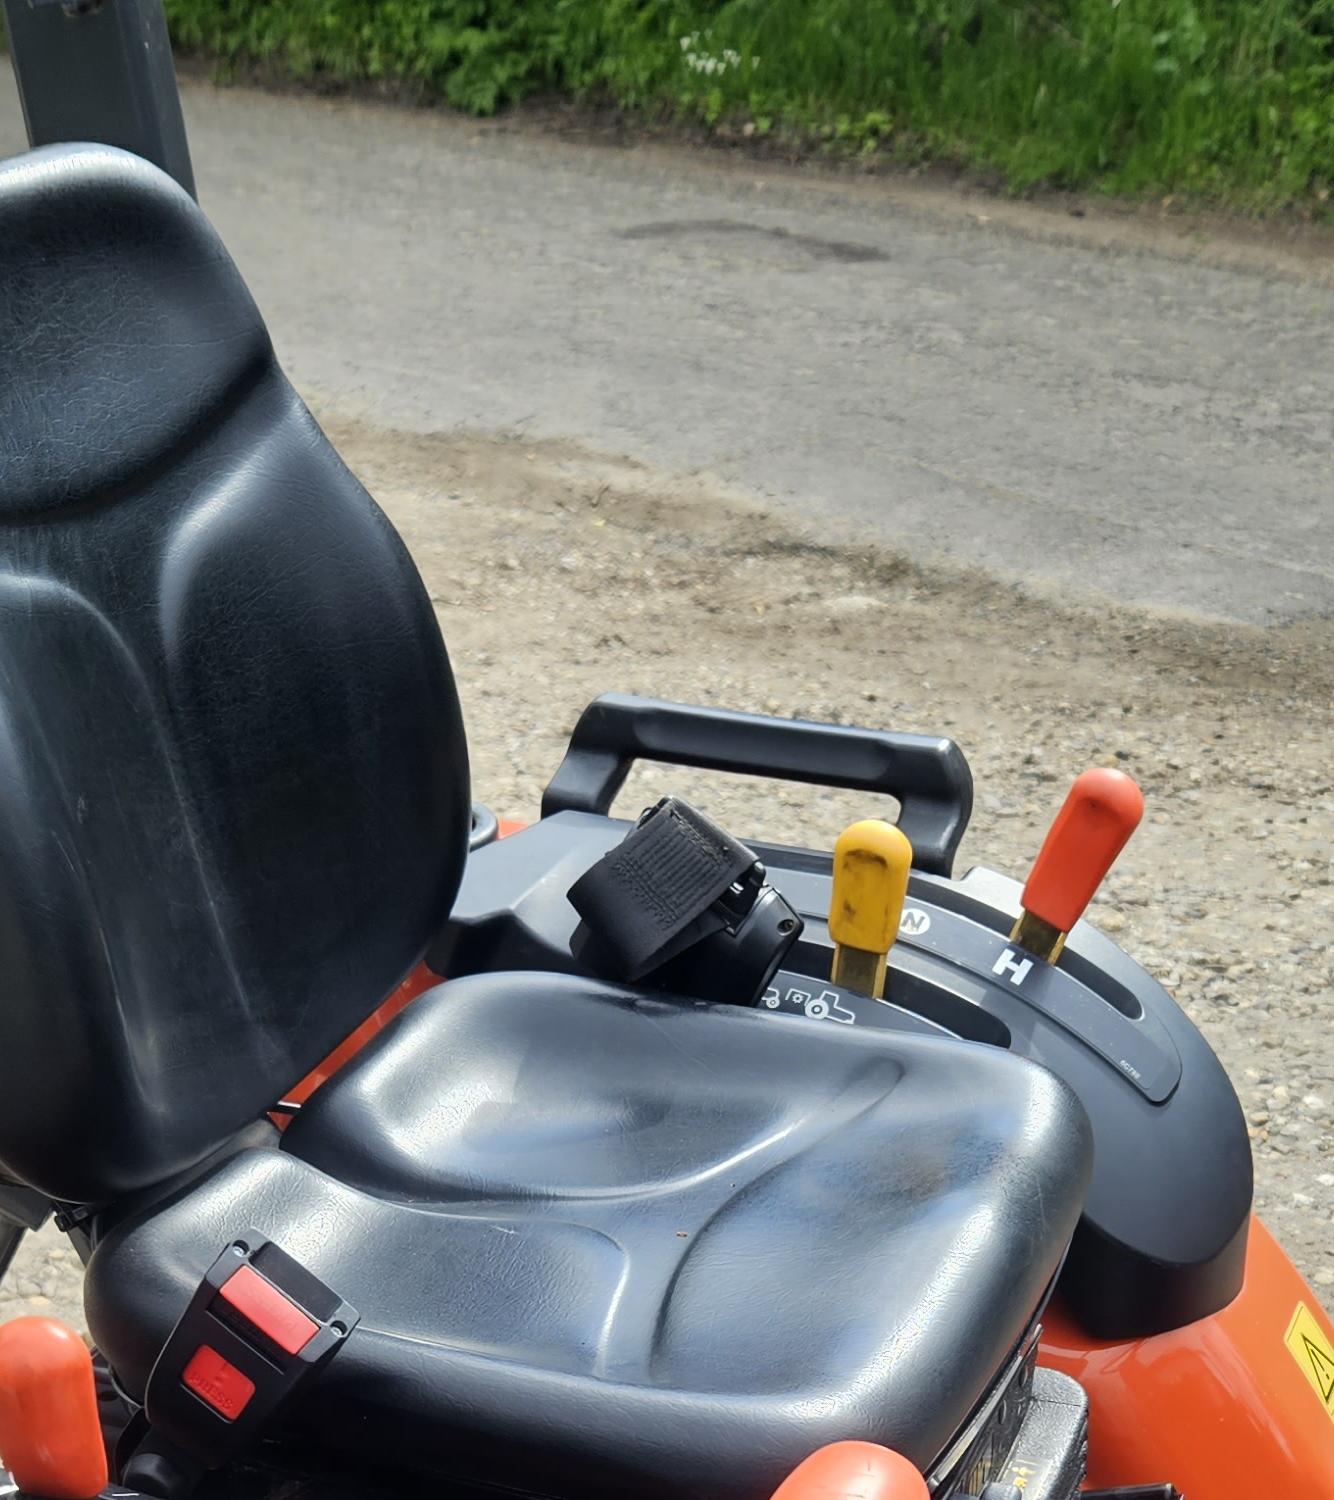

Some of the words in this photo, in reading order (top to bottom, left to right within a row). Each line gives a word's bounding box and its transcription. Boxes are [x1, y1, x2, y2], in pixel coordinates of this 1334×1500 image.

[900, 910, 926, 932] N
[992, 948, 1034, 986] H
[189, 1371, 234, 1410] PRESS
